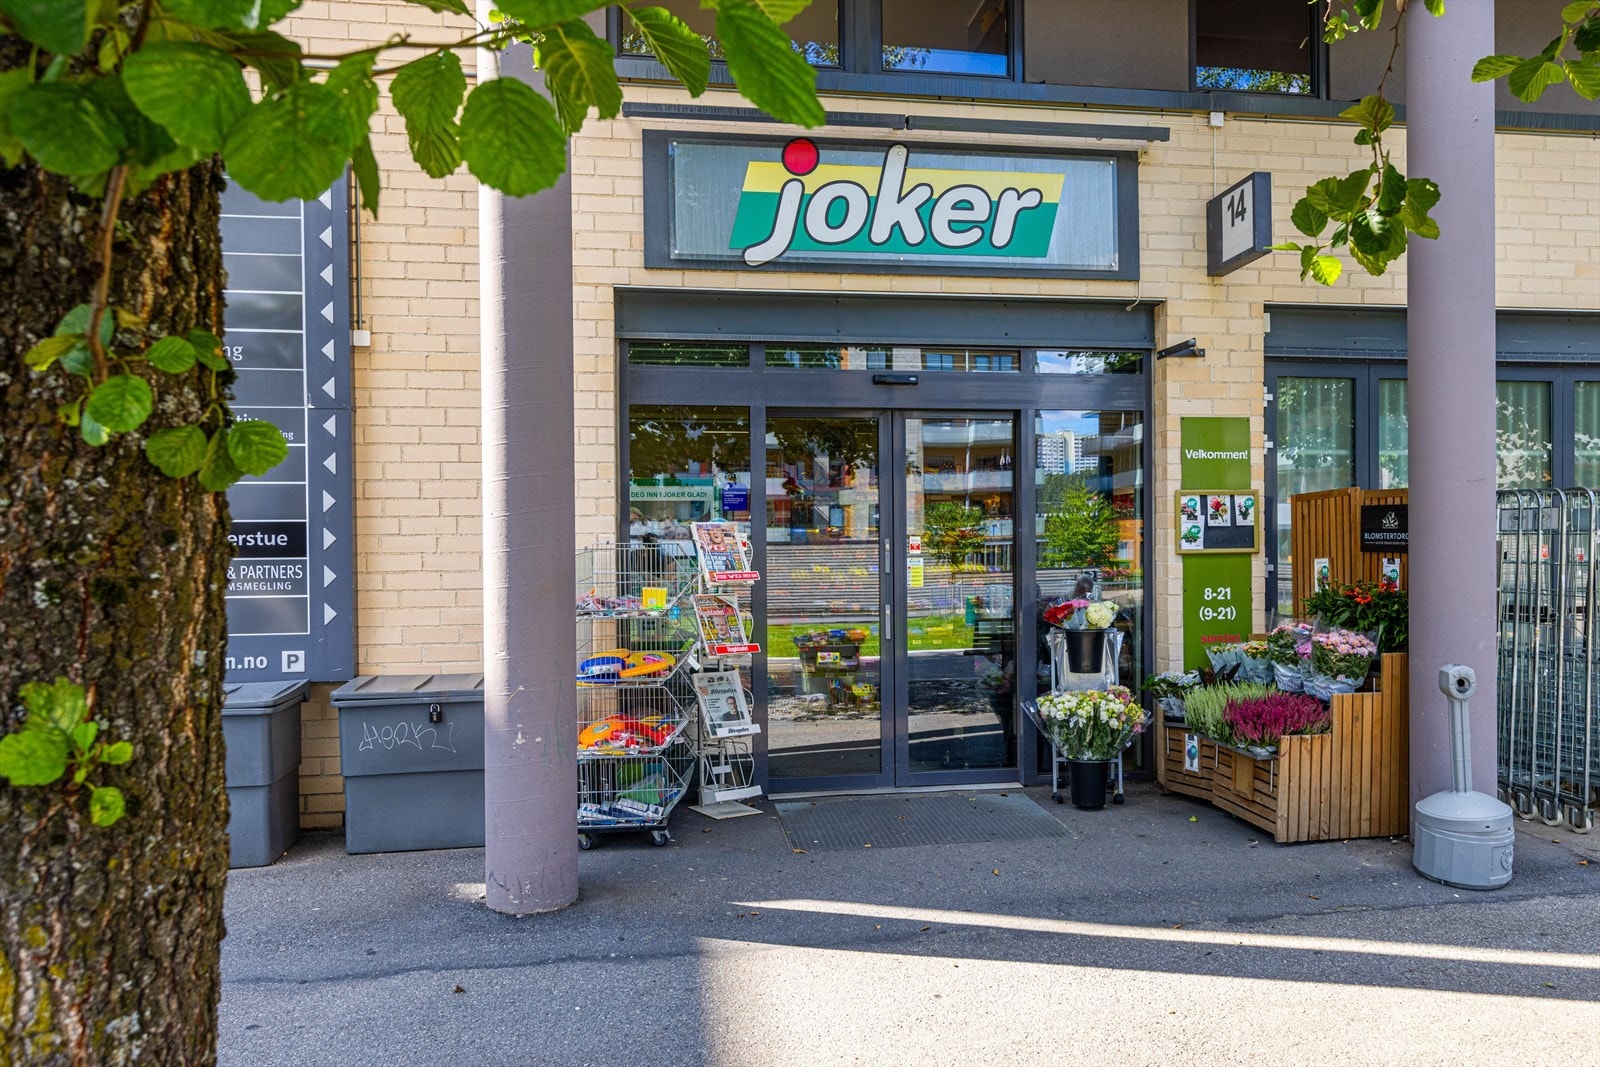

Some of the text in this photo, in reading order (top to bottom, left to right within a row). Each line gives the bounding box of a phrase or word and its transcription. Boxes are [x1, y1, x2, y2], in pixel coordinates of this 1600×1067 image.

[742, 136, 1043, 266] joker
[1227, 188, 1247, 228] 14
[1185, 449, 1248, 459] Velkommen!
[226, 564, 303, 580] & PARTNERS
[1204, 587, 1231, 600] 8-21
[1199, 605, 1236, 622] (9-21)
[287, 653, 299, 669] P
